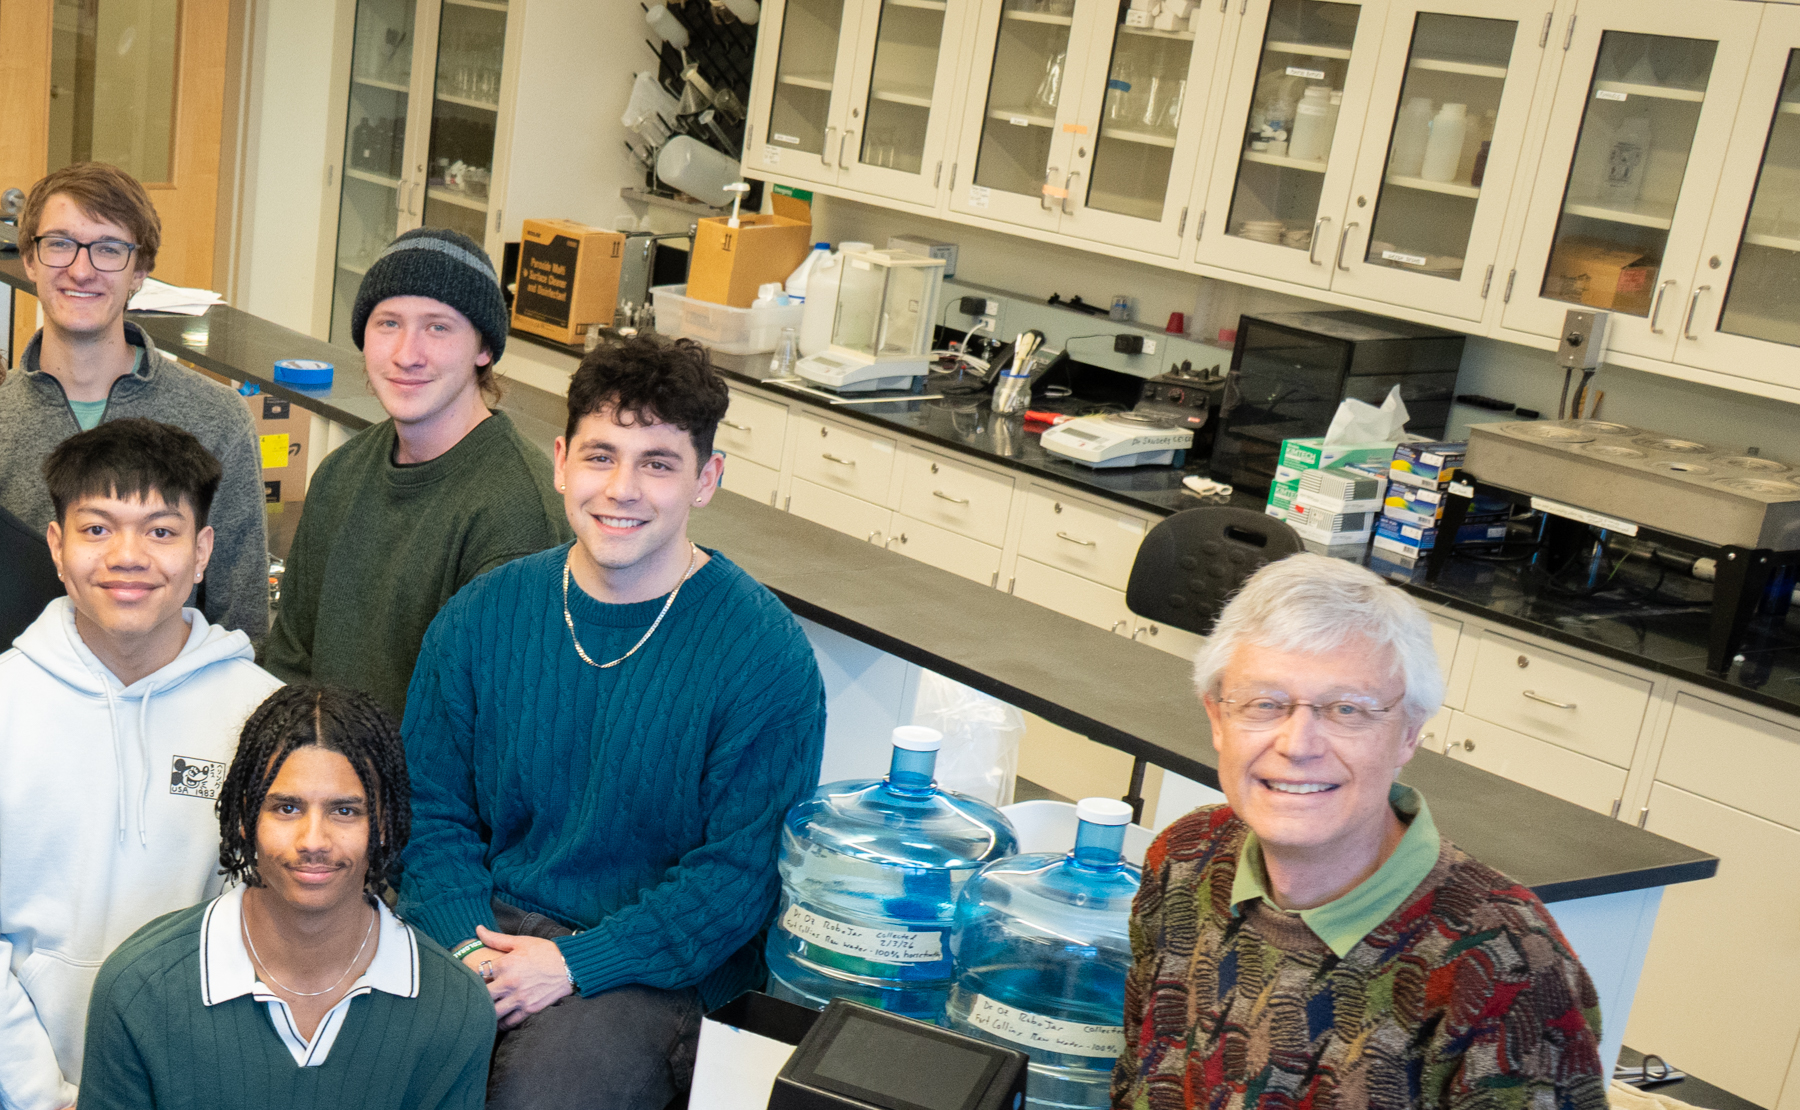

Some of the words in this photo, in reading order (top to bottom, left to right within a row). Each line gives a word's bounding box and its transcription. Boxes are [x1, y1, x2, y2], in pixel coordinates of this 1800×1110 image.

[1286, 447, 1317, 462] KIMTECH
[172, 786, 188, 794] USA
[196, 789, 215, 797] 1983
